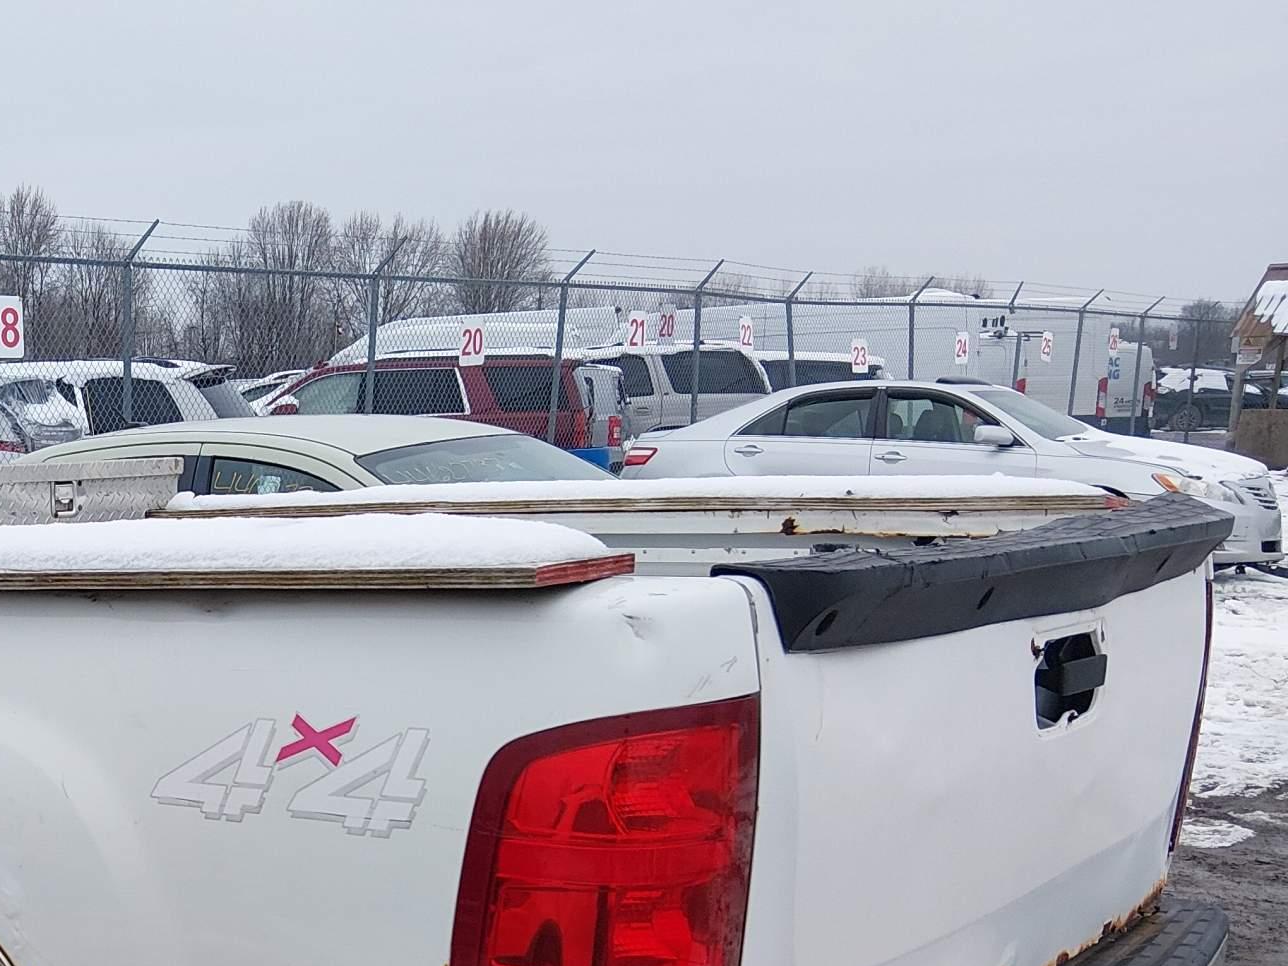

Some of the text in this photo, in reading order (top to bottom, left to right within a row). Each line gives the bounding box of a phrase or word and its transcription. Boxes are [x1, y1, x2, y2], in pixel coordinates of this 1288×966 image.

[629, 318, 645, 347] 21
[659, 314, 674, 338] 20
[741, 323, 753, 347] 22
[462, 328, 483, 356] 20
[956, 339, 967, 358] 24
[1042, 336, 1053, 357] 25
[853, 346, 867, 366] 23
